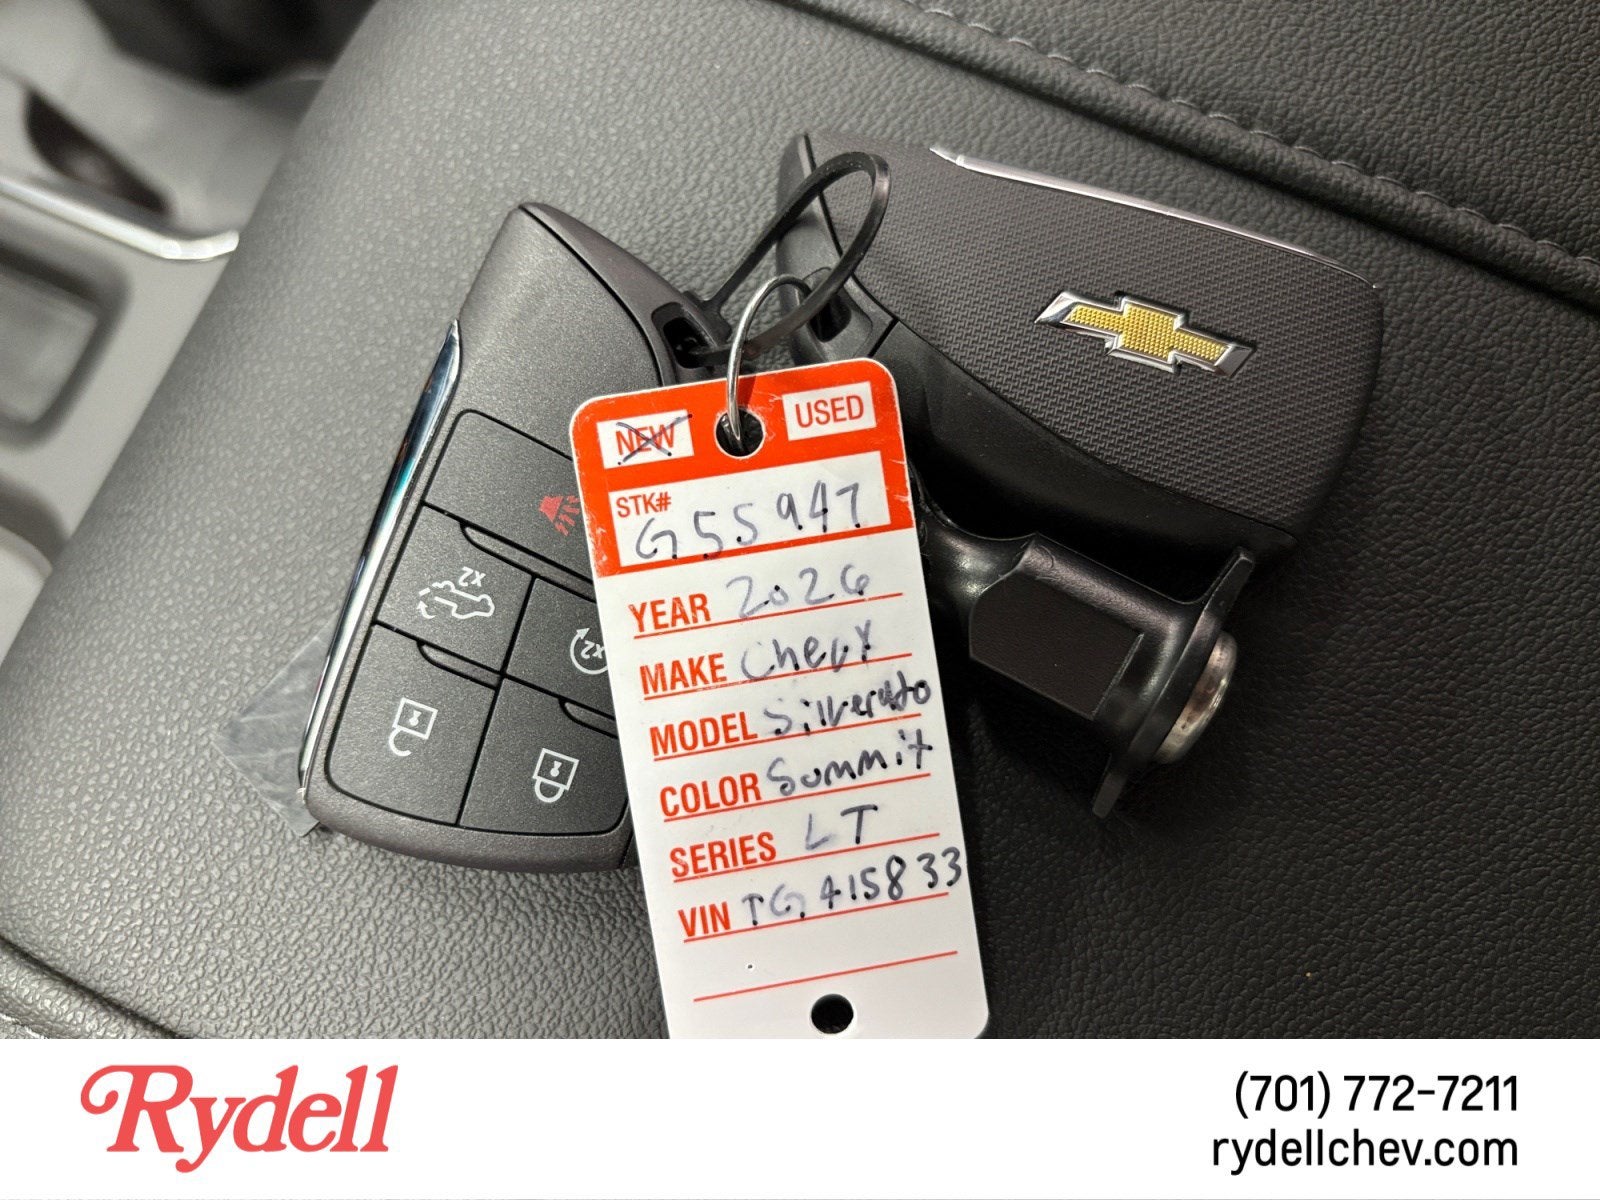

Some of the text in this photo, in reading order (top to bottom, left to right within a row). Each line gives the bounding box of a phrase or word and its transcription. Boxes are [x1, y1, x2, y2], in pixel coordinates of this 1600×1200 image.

[794, 394, 865, 429] USED
[615, 423, 676, 456] NEW
[616, 491, 672, 518] STK#
[628, 592, 712, 633] YEAR
[726, 563, 870, 619] 2026
[639, 652, 728, 696] MAKE
[650, 711, 758, 757] MODEL
[766, 728, 933, 796] Summit
[659, 772, 762, 818] COLOR
[670, 831, 777, 878] SERIES
[678, 901, 731, 938] VIN
